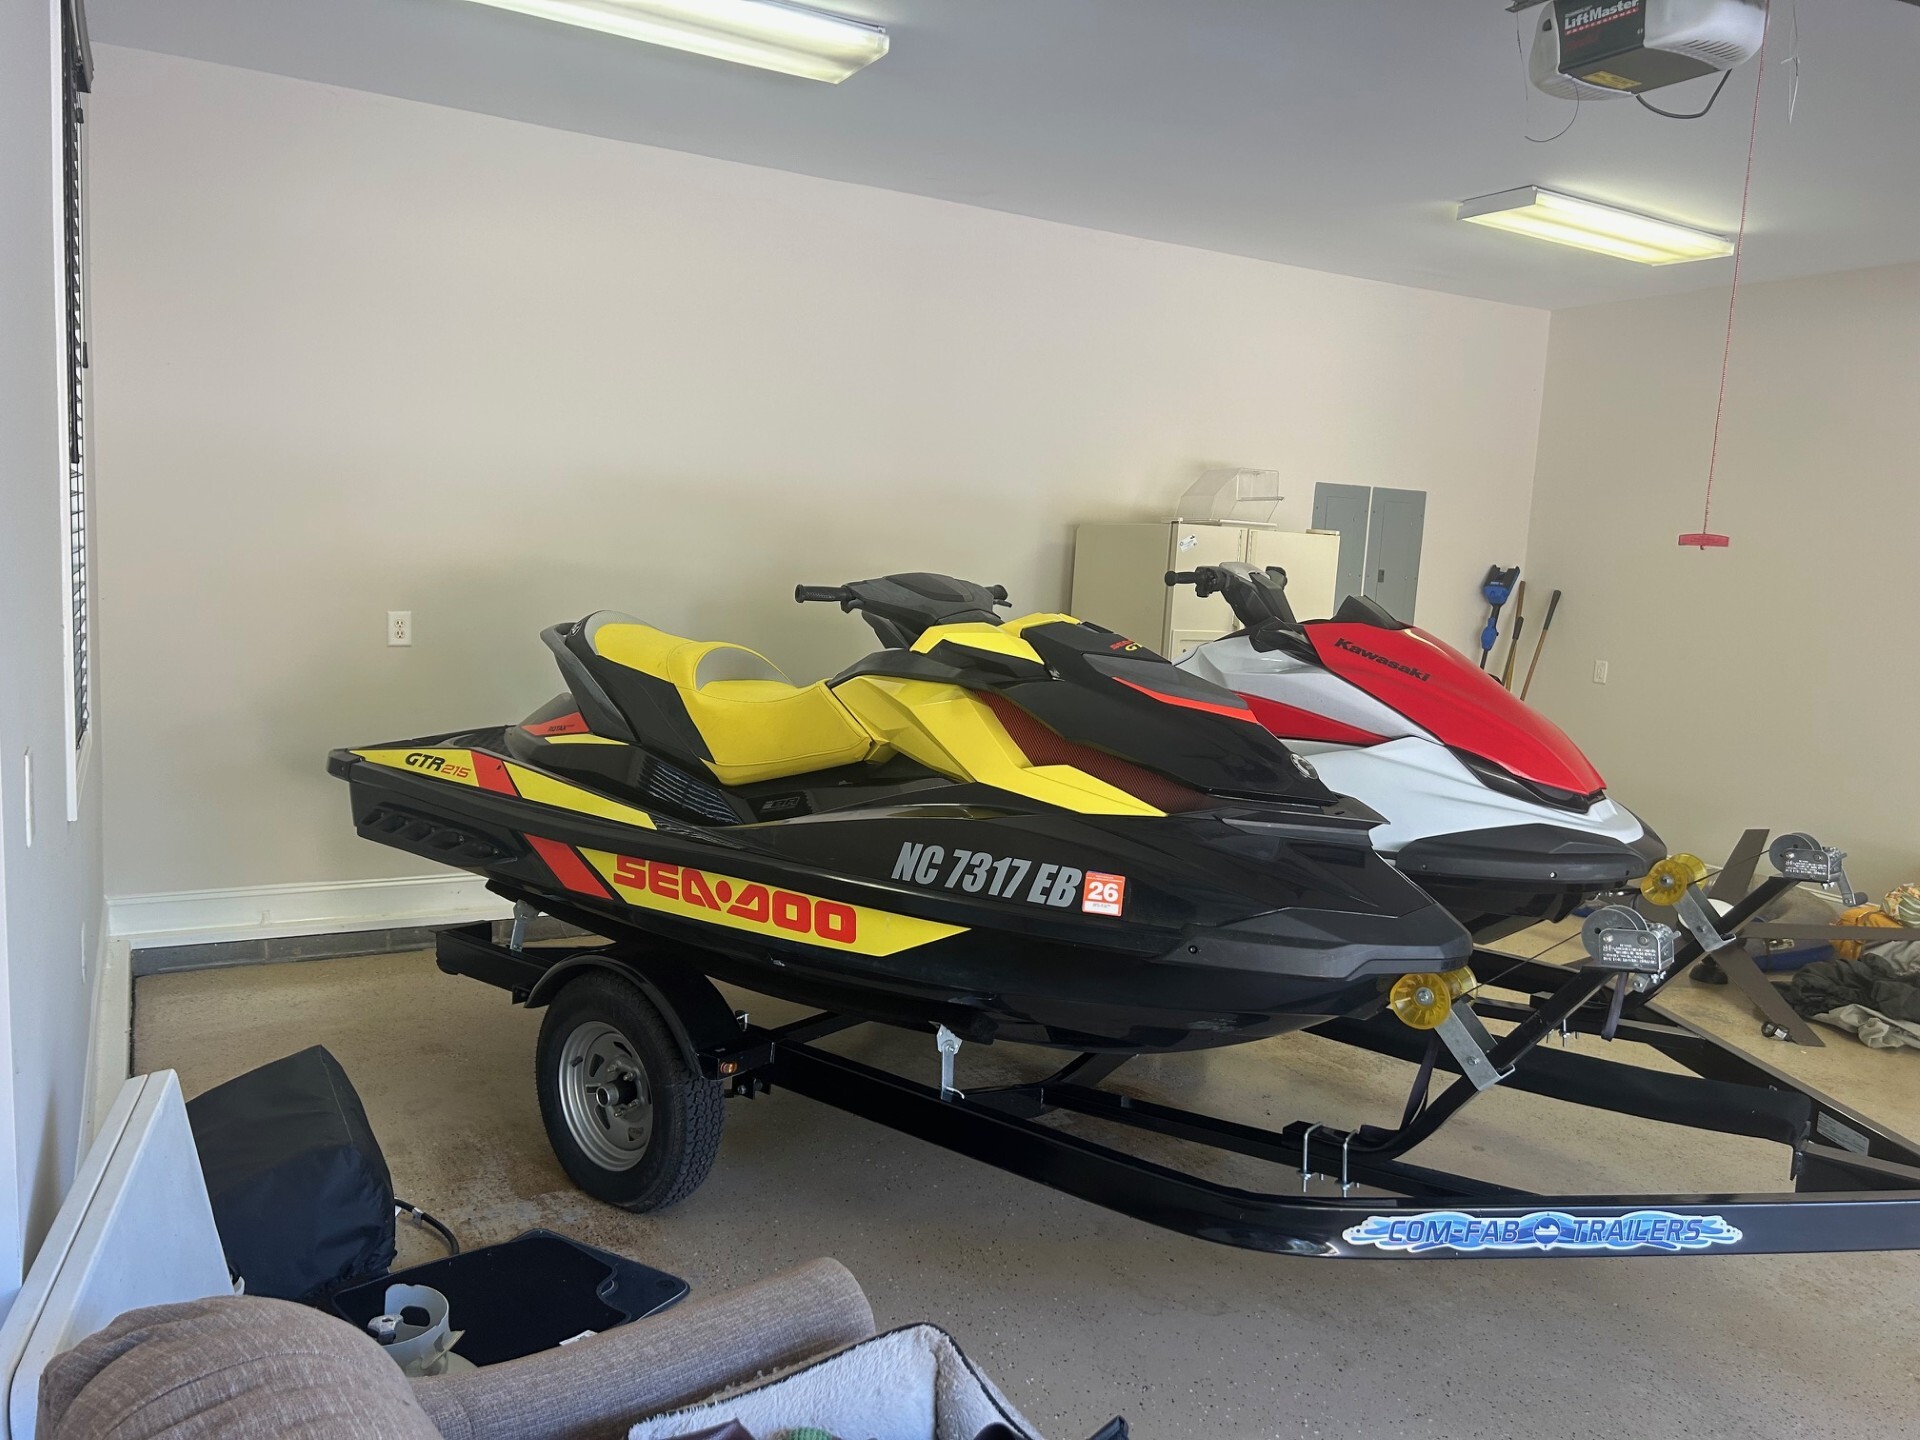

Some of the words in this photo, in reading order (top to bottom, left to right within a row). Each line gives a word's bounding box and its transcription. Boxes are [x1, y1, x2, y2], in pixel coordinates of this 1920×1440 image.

[1564, 0, 1640, 30] LiftMaster
[1334, 637, 1431, 681] Kawasaki
[405, 752, 446, 772] GTR
[440, 764, 471, 779] 215
[891, 841, 945, 886] NC
[944, 849, 1032, 899] 7317
[1026, 862, 1083, 909] EB
[1087, 880, 1120, 903] 26
[1388, 1219, 1520, 1243] COM-FAB
[1572, 1218, 1704, 1242] TRAILERS
